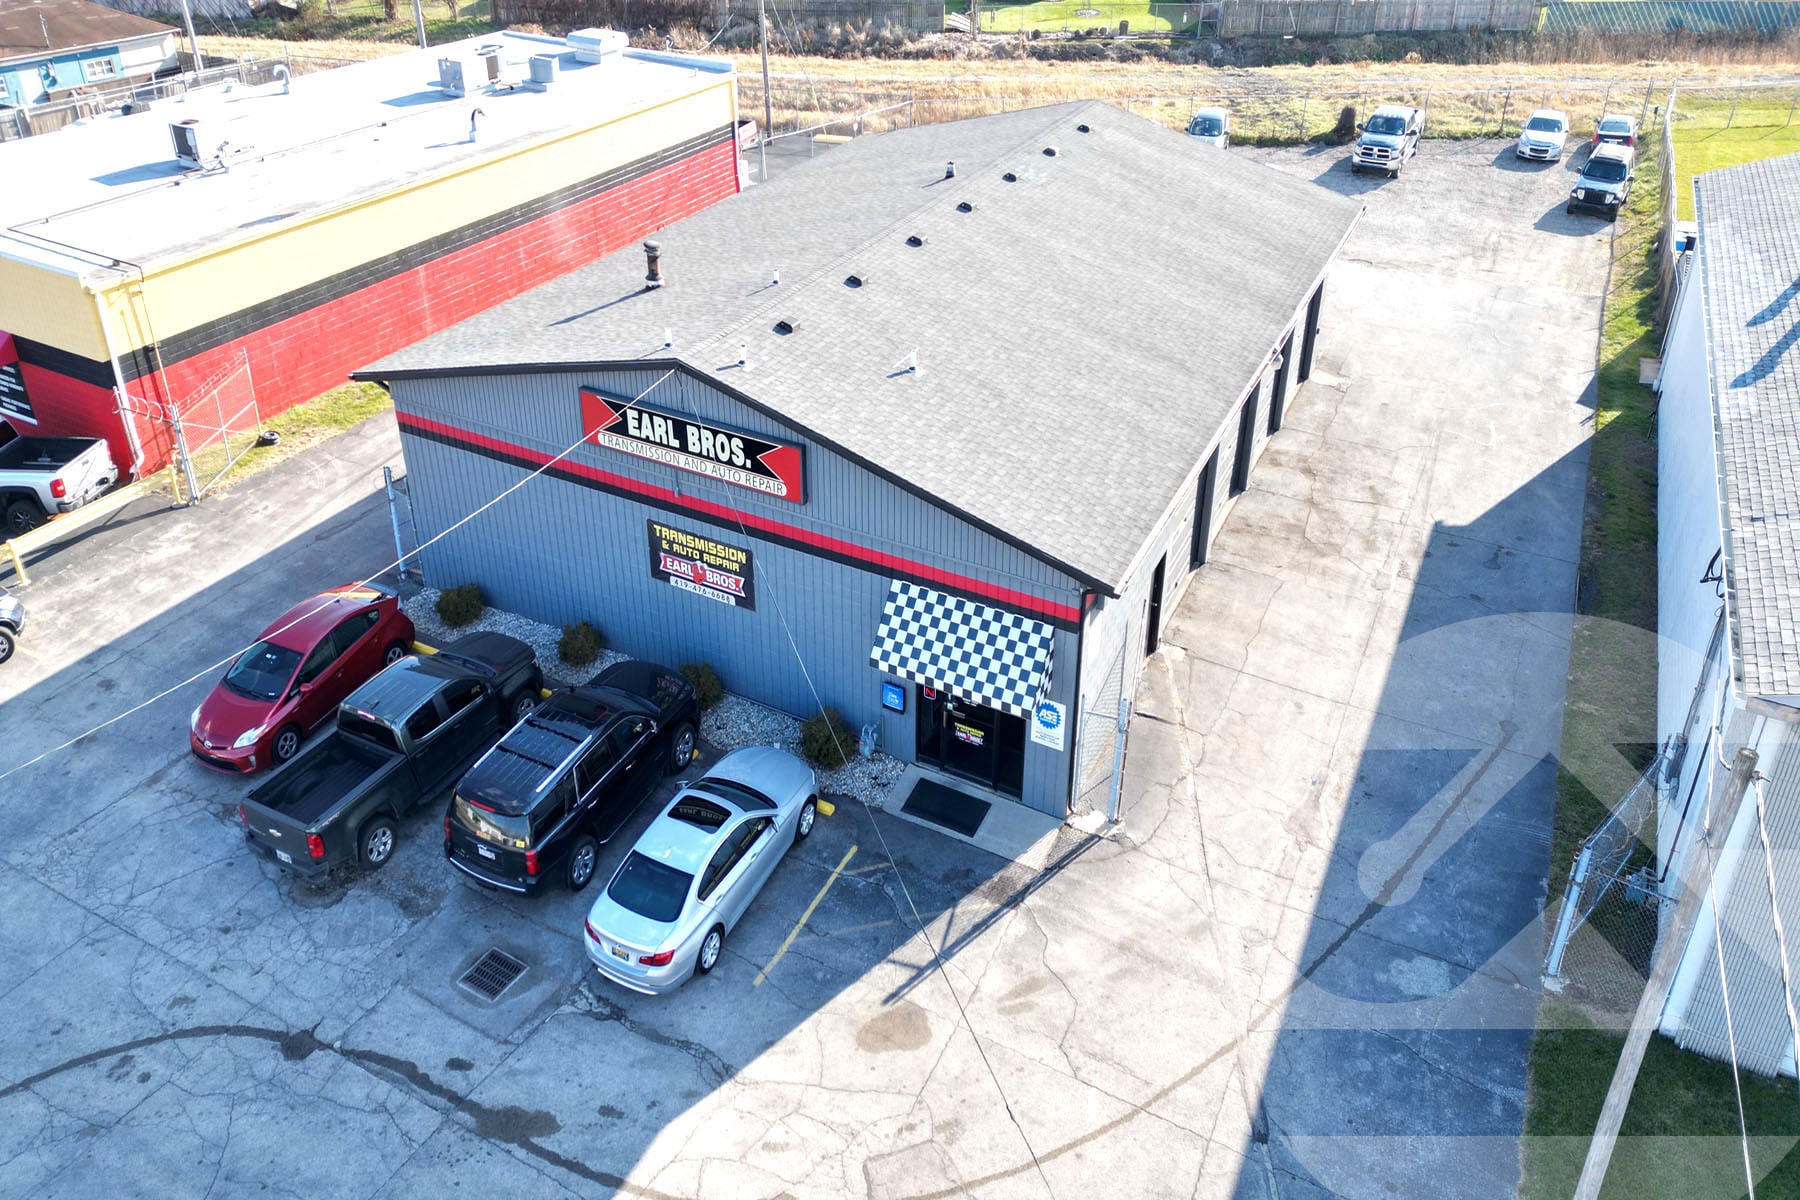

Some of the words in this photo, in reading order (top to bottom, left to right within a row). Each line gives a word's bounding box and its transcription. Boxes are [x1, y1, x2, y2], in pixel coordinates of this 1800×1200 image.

[626, 408, 680, 448] EARL
[686, 424, 752, 469] BROS.
[602, 434, 680, 466] TRANSMISSION
[684, 457, 707, 472] AND
[712, 464, 741, 481] AUTO
[745, 473, 783, 495] REPAIR
[653, 524, 746, 564] TRANSMISSION
[661, 540, 670, 550] &
[673, 543, 700, 560] AUTO
[703, 553, 740, 572] REPAIR
[666, 558, 694, 576] EARL
